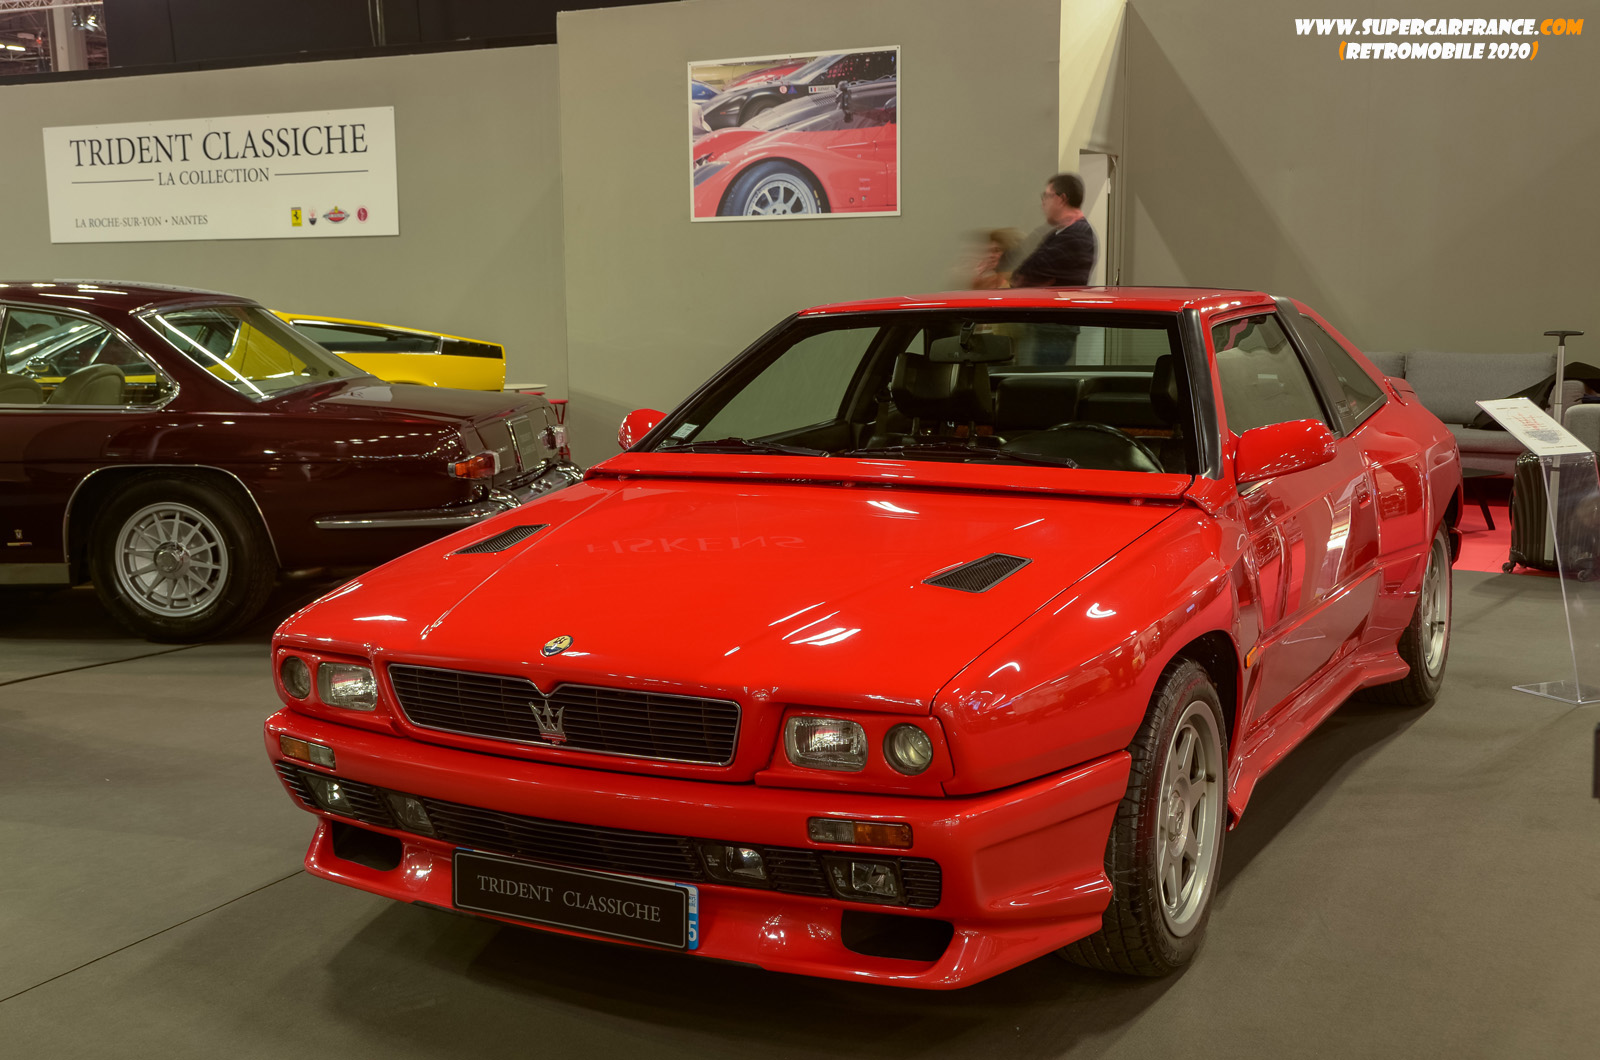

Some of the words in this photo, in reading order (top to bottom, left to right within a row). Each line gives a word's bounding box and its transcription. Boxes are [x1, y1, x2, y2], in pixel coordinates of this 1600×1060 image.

[69, 133, 193, 168] TRIDENT
[202, 123, 369, 161] CLASSICHE
[158, 171, 176, 186] LA
[178, 167, 271, 186] COLLECTION
[75, 218, 87, 229] LA
[88, 216, 163, 229] ROCHE-SUR-YON
[171, 214, 209, 226] NANTES
[477, 874, 553, 903] TRIDENT
[562, 890, 661, 923] CLASSICHE
